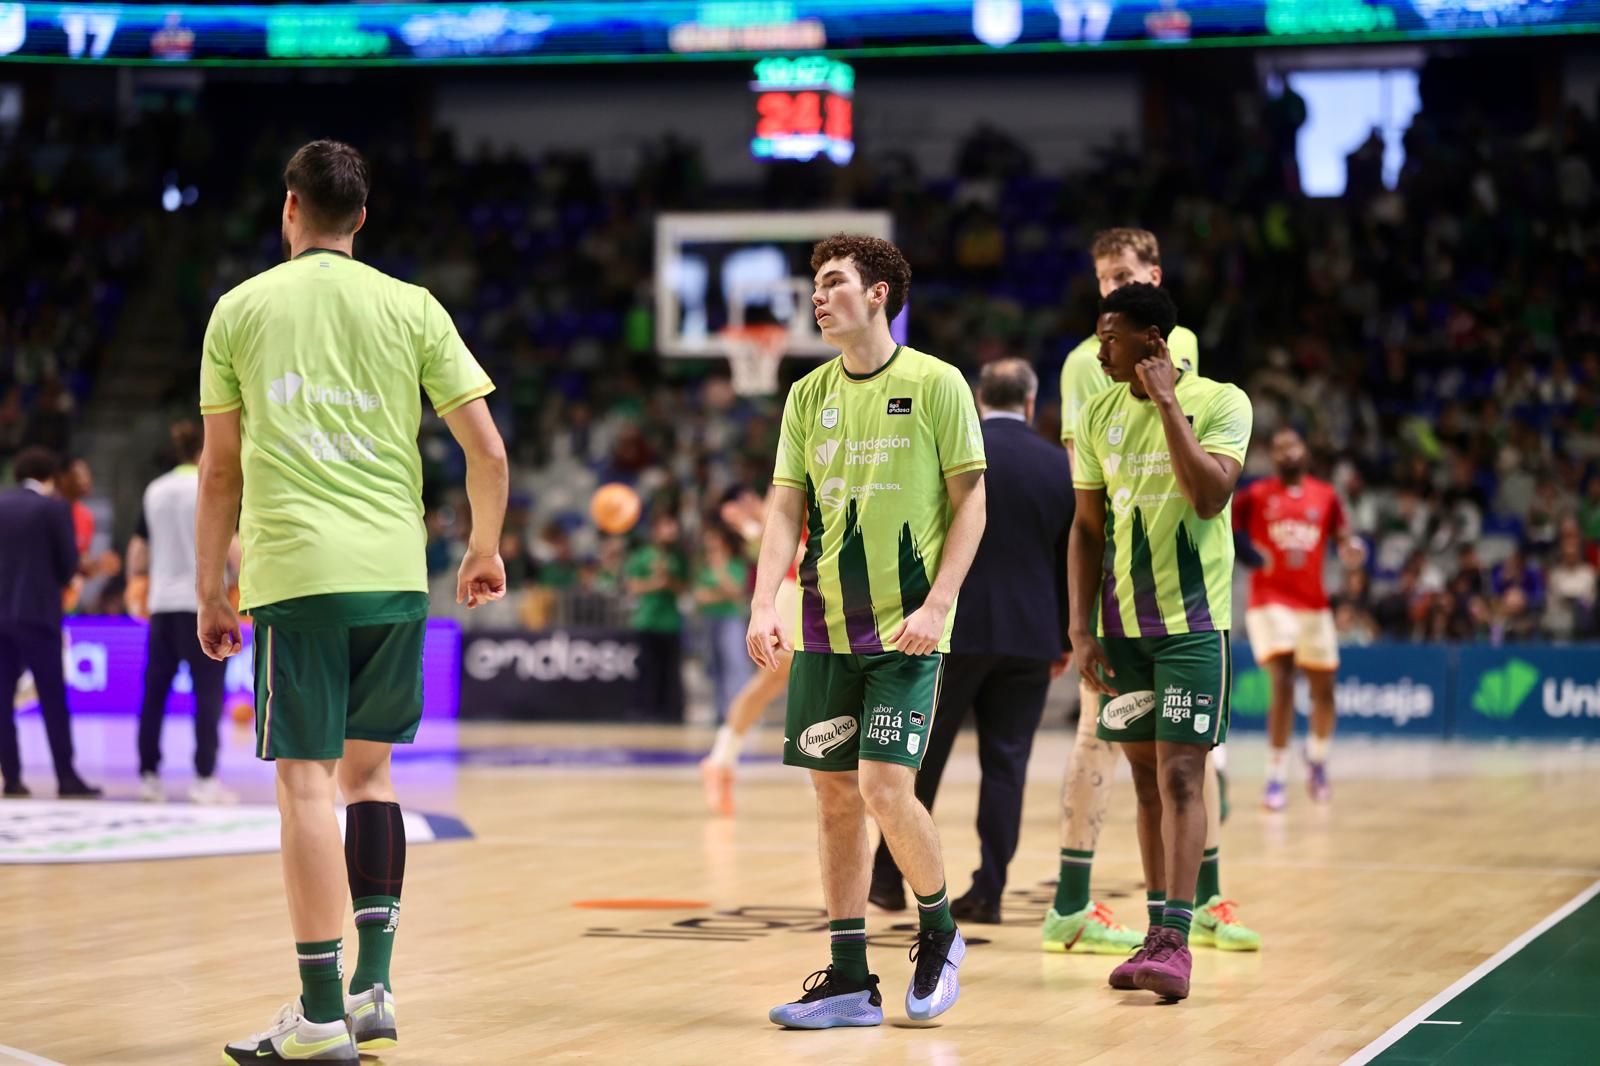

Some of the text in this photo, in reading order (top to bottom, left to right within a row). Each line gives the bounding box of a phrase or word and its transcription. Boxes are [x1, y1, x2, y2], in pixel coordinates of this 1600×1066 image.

[873, 704, 894, 714] sabor
[1163, 703, 1191, 723] laga
[874, 710, 903, 729] má
[803, 719, 855, 751] famadesa
[867, 722, 902, 746] laga
